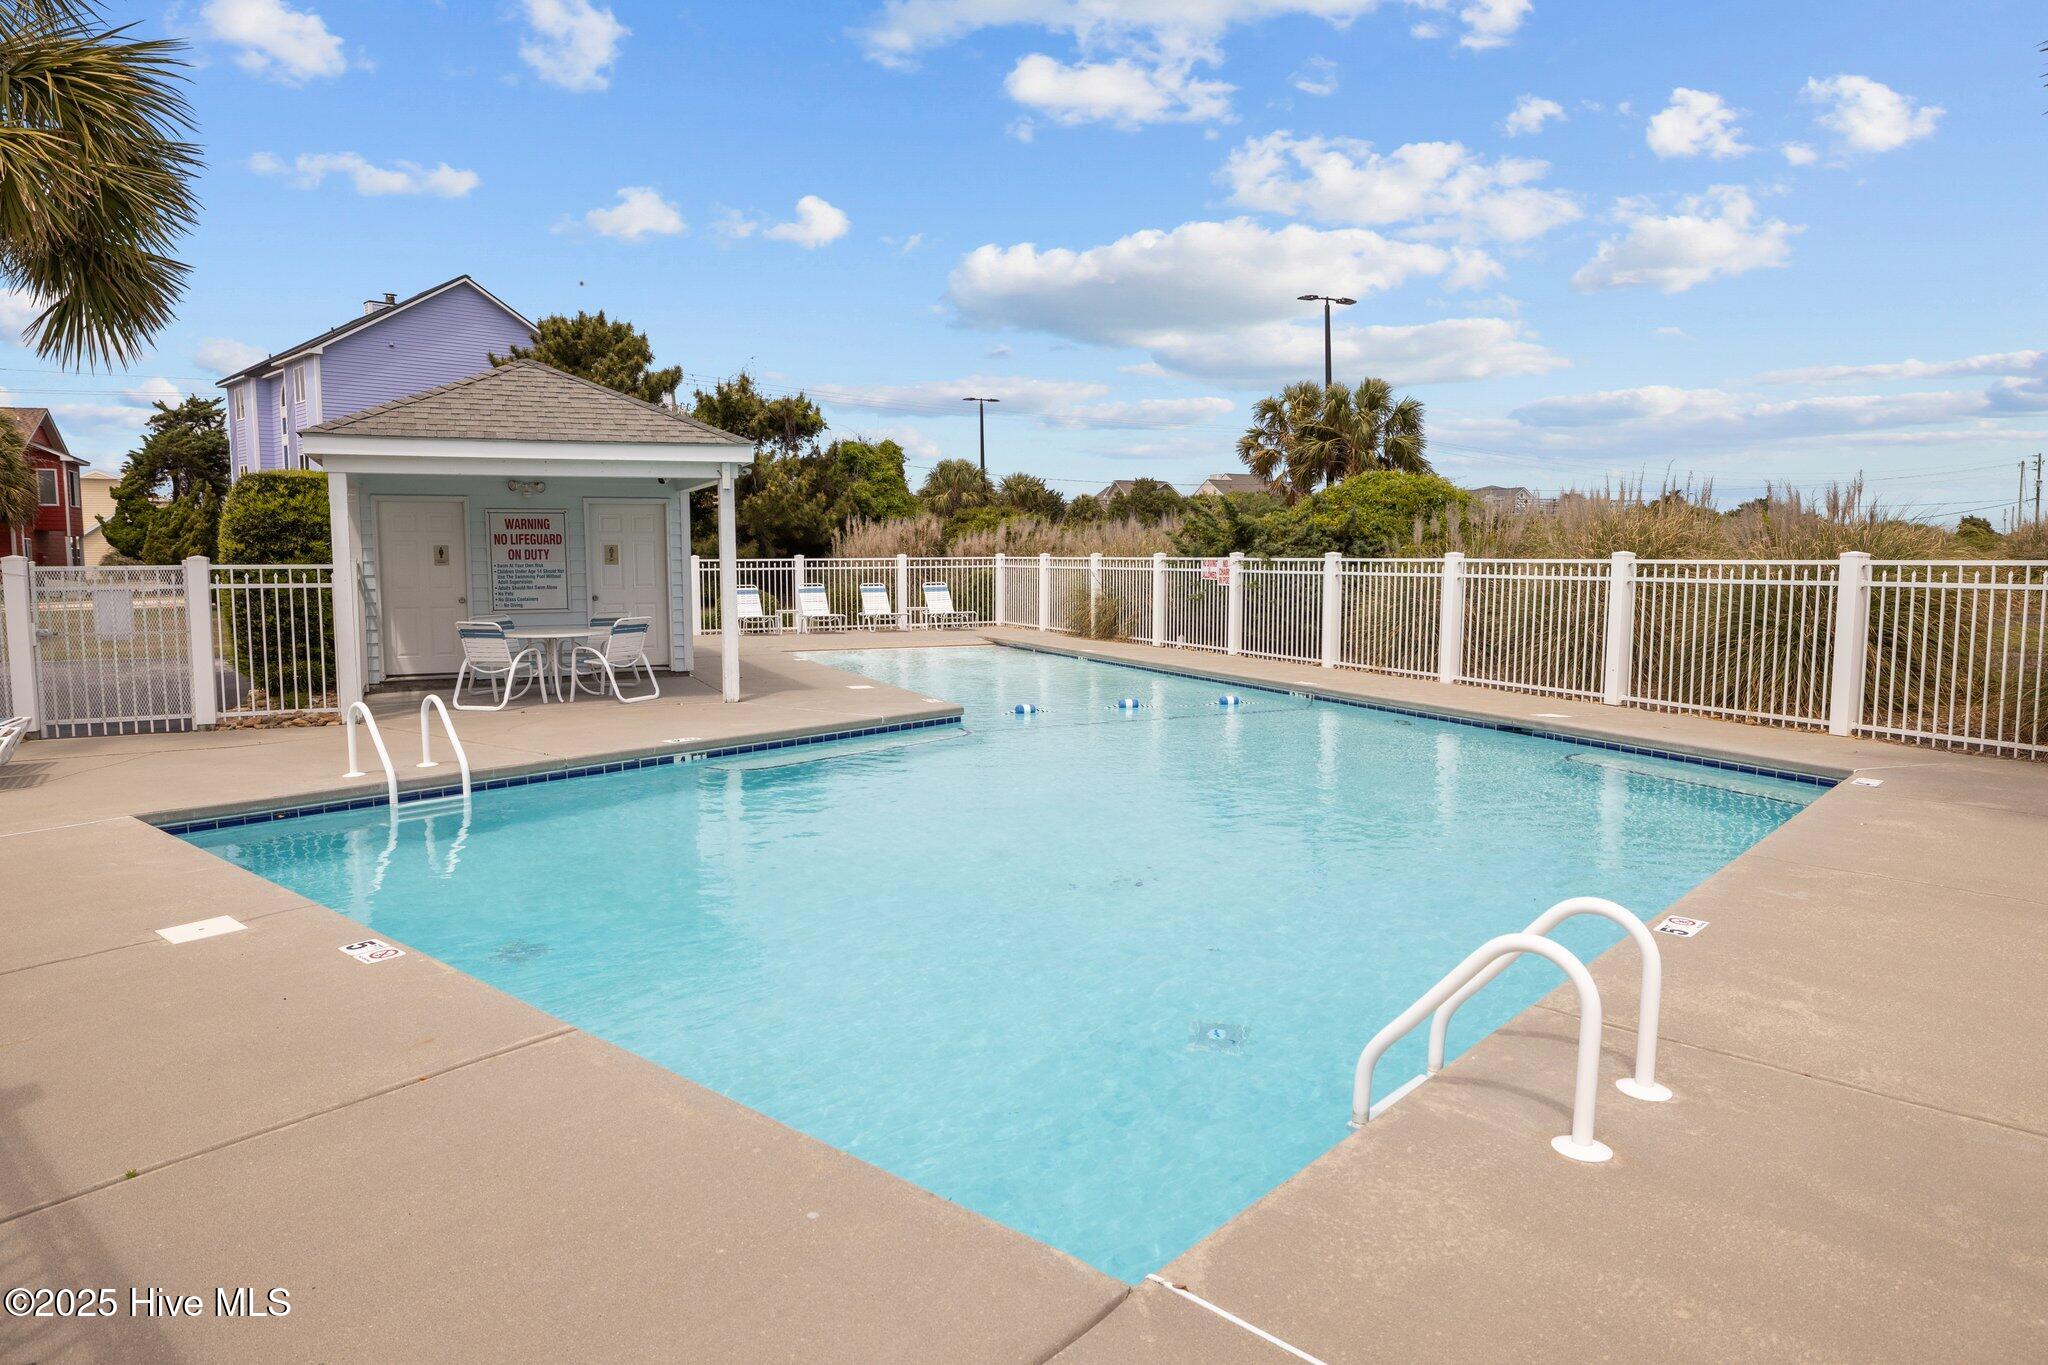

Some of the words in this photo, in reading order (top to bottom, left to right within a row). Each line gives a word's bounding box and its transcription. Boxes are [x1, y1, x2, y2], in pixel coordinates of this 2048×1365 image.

[504, 518, 551, 530] WARNING
[494, 533, 508, 545] NO
[510, 533, 563, 545] LIFEGUARD
[508, 549, 522, 561] ON
[524, 549, 550, 560] DUTY
[346, 940, 377, 951] 5
